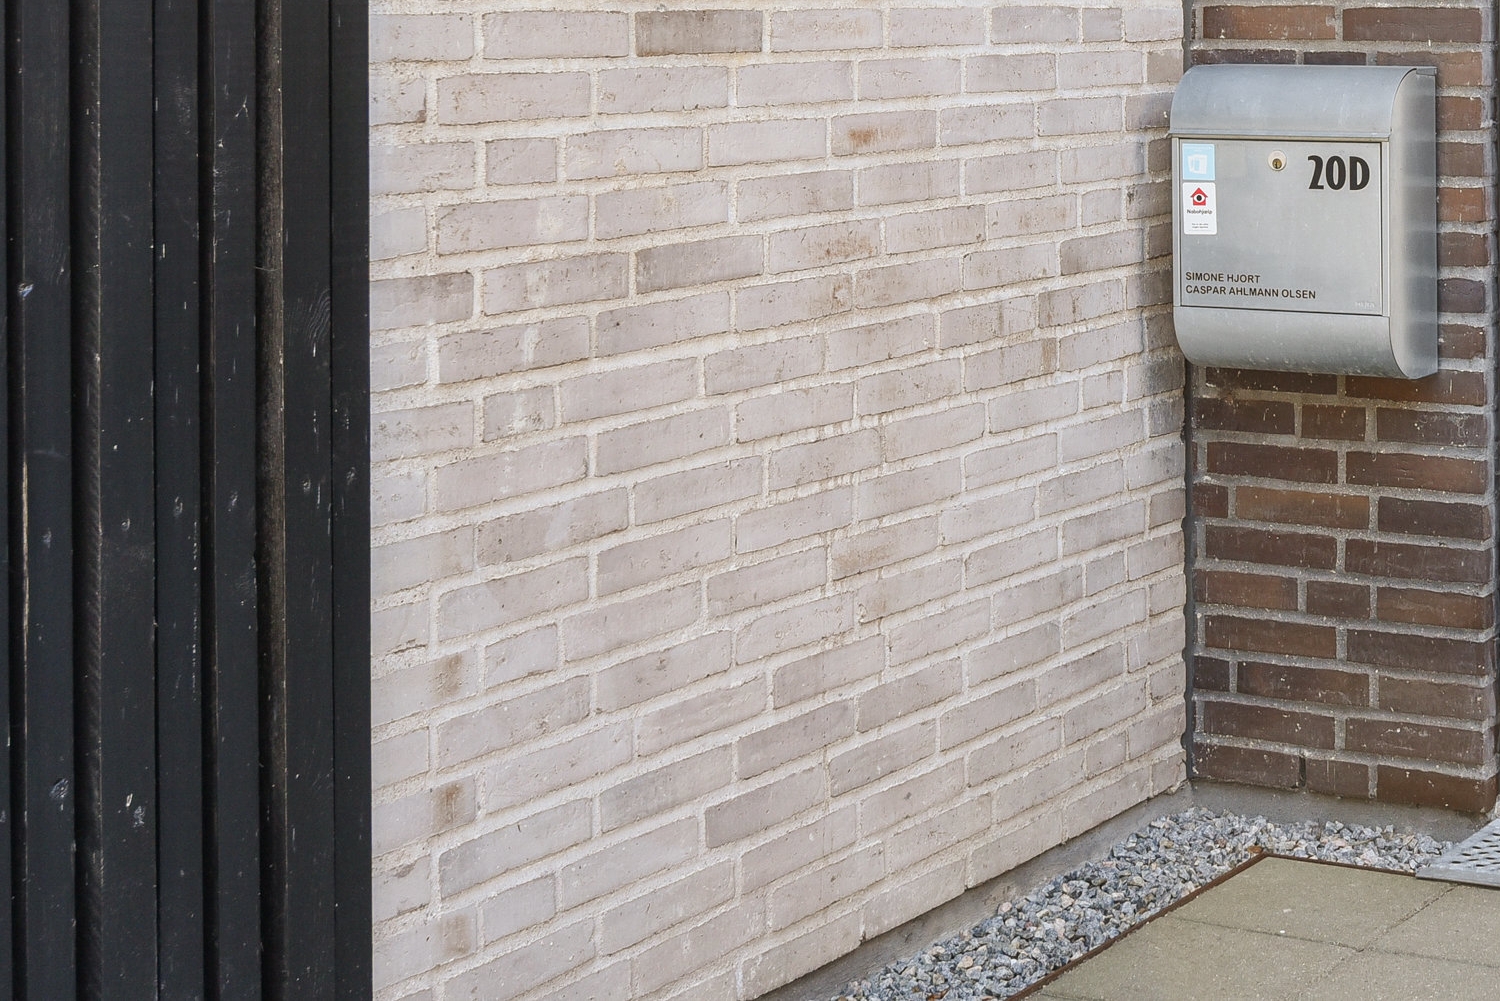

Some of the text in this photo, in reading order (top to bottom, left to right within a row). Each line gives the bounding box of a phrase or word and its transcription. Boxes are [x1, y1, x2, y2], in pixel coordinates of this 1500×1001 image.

[1307, 155, 1370, 190] 20D
[1185, 271, 1261, 284] SIMONE HJORT
[1185, 285, 1316, 299] CASPAR AHLMANN OLSEN
